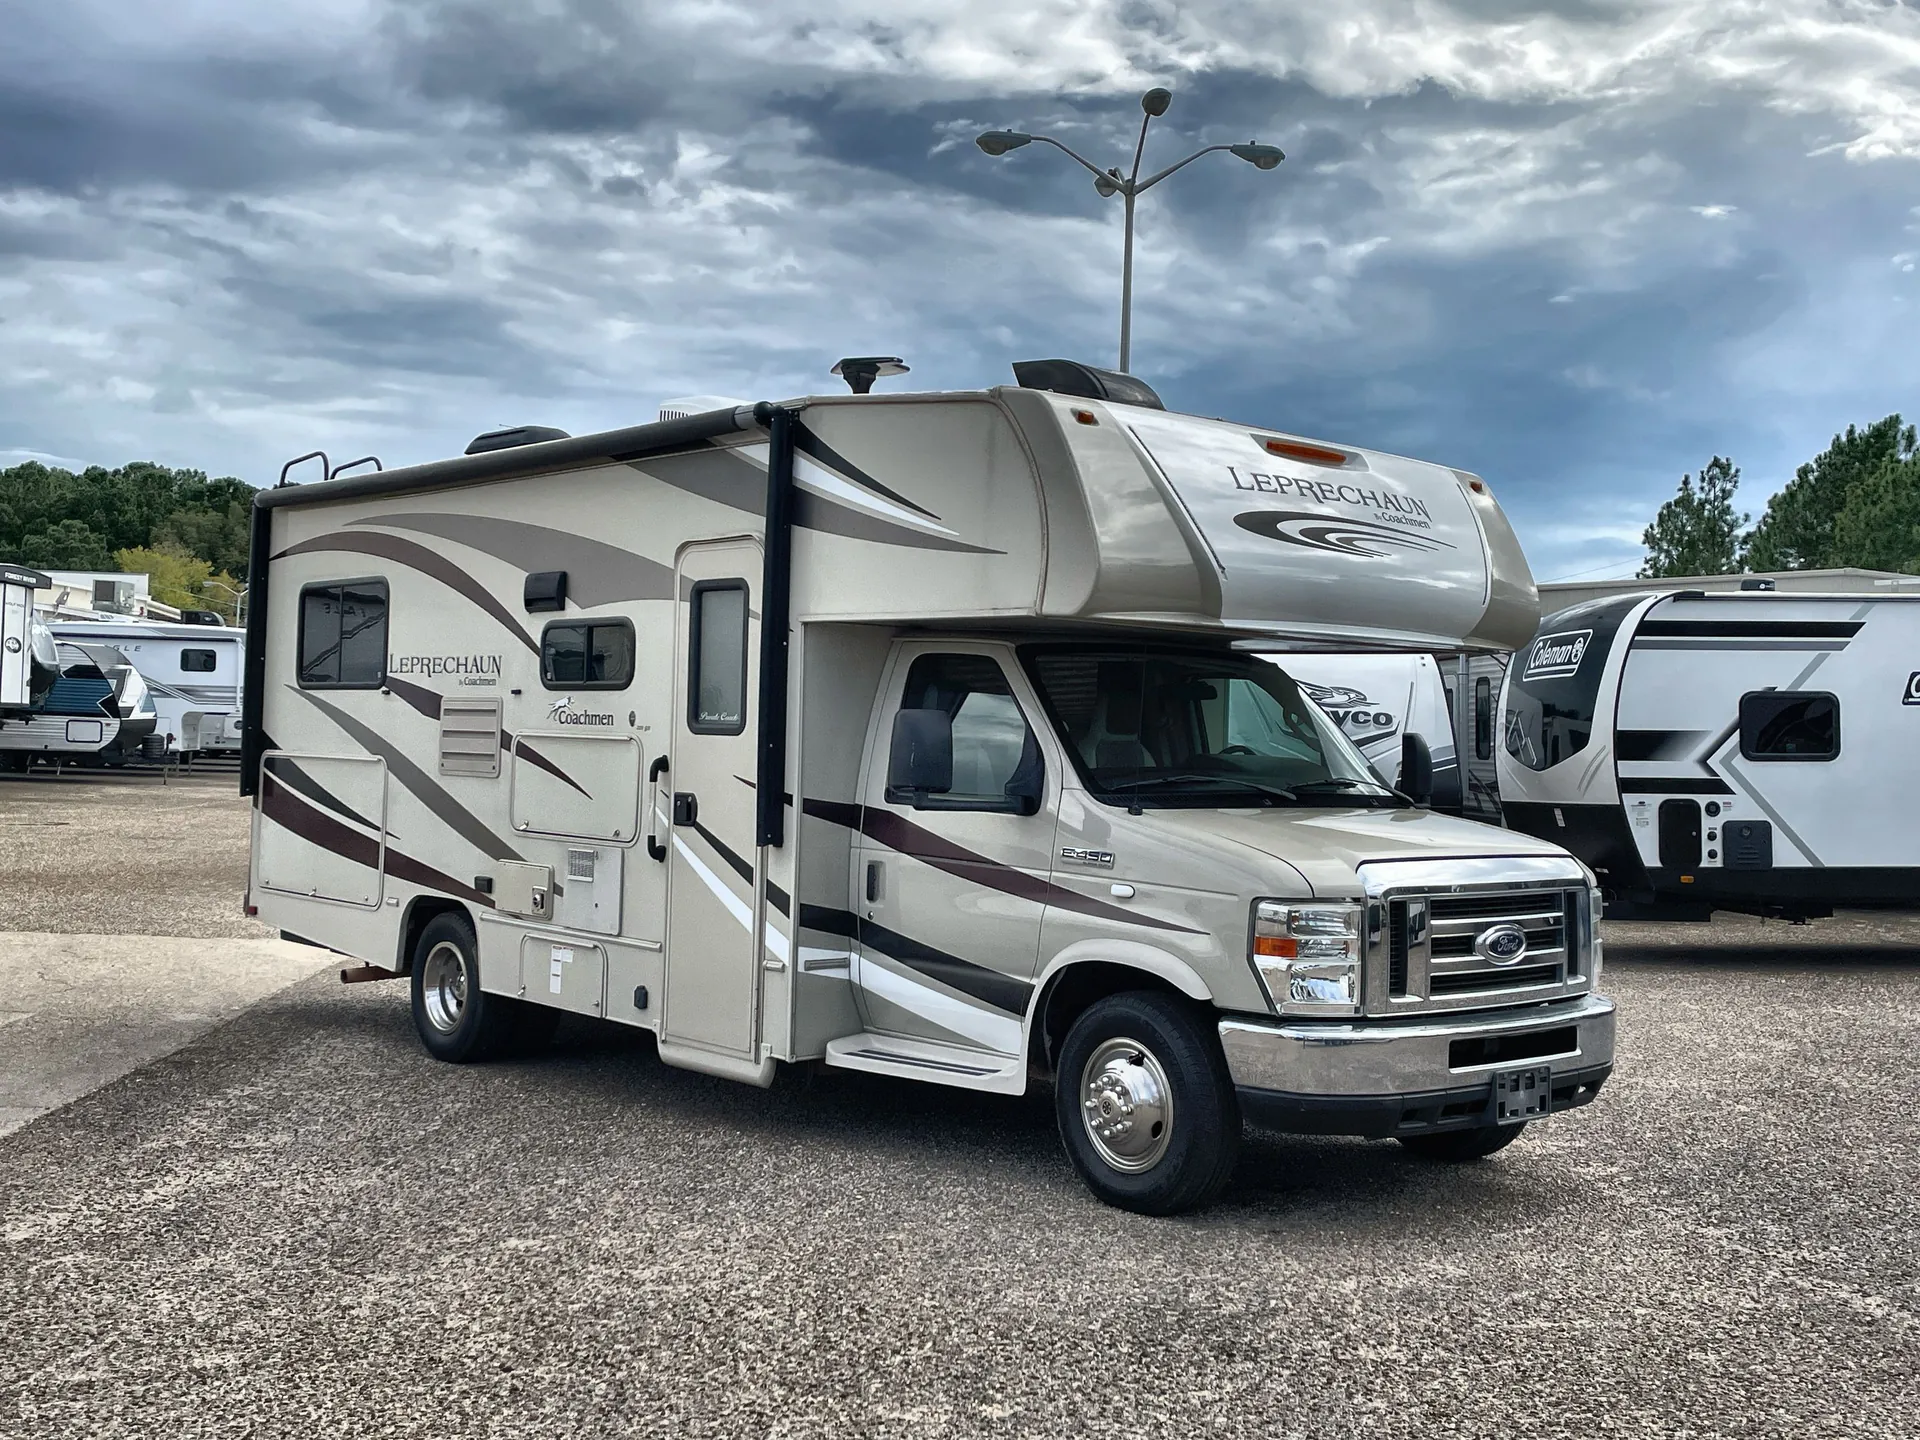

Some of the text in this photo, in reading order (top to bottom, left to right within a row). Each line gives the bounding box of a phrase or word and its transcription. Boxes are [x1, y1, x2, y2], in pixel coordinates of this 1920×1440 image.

[1227, 466, 1432, 522] LEPRECHAUN
[1382, 512, 1431, 529] Coachmen
[5, 572, 37, 584] FOREST RIVER
[112, 644, 142, 652] GLE
[1530, 640, 1573, 669] Coleman
[389, 653, 502, 678] LEPRECHAUN
[464, 676, 497, 686] Coachmen
[558, 709, 614, 726] Coachmen
[1325, 710, 1393, 727] YCO
[1497, 935, 1519, 952] Ford
